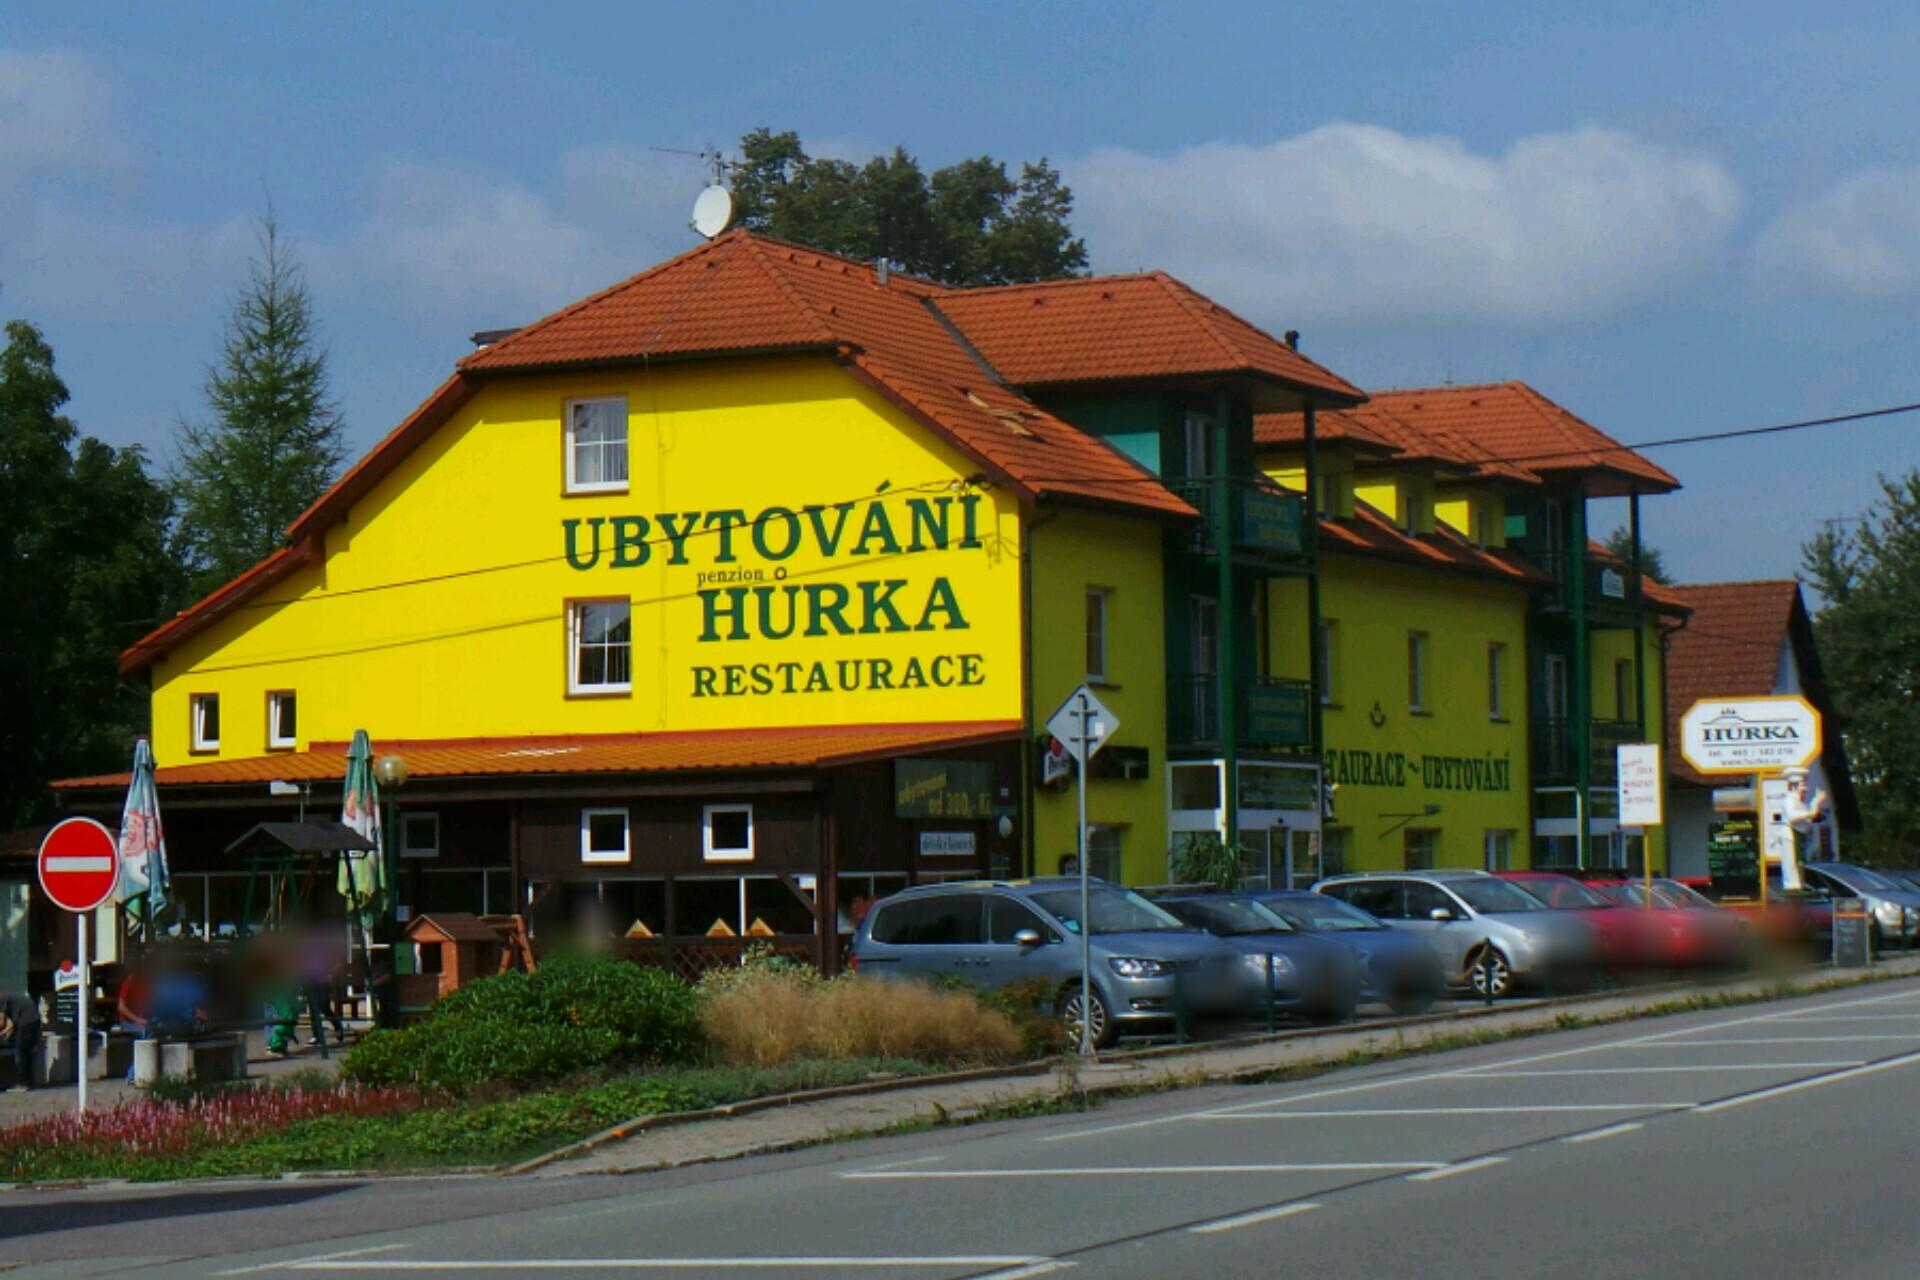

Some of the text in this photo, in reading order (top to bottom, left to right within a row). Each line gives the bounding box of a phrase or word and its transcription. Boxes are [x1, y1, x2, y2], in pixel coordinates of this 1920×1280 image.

[697, 565, 765, 588] penzion
[697, 567, 970, 641] HŮRKA
[692, 654, 985, 697] RESTAURACE
[1326, 749, 1405, 787] TAURACE
[1422, 750, 1510, 791] UBYTOVÁNÍ
